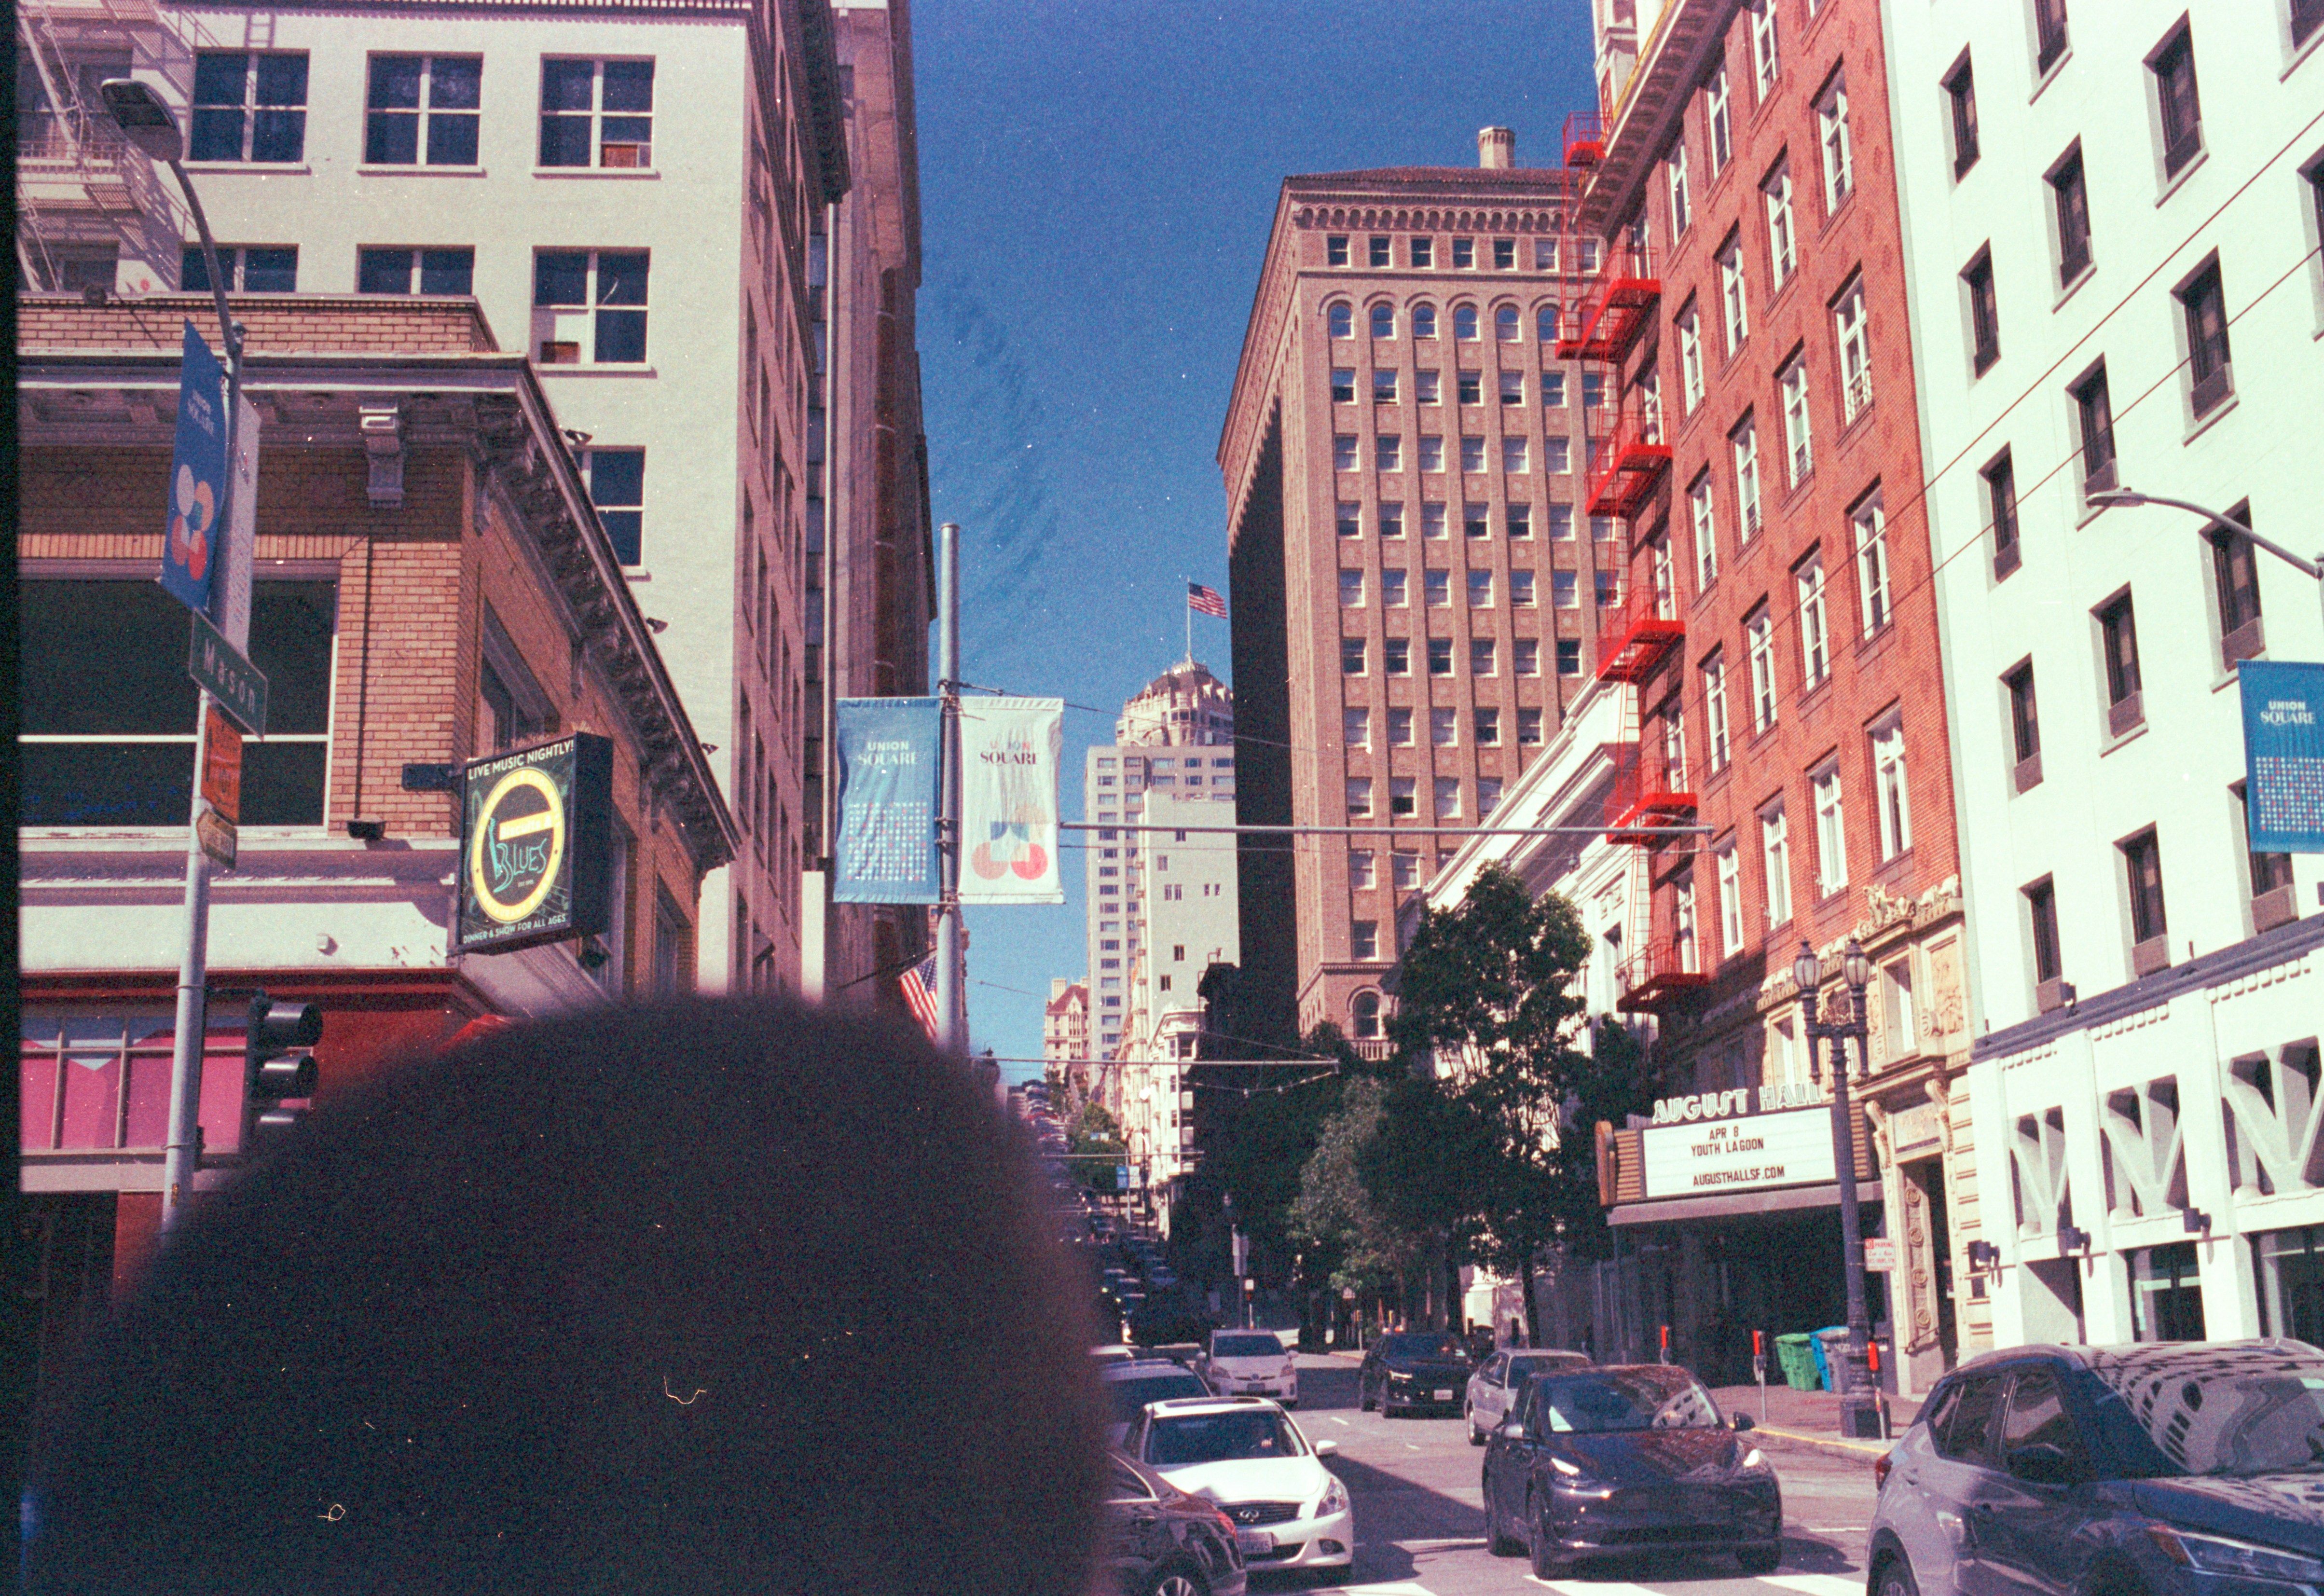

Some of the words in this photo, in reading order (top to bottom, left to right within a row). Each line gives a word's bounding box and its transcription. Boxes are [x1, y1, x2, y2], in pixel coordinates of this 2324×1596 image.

[2268, 701, 2306, 711] UNION
[2260, 711, 2316, 726] SQUARE
[867, 741, 909, 751] UNION
[468, 764, 490, 780] LIVE
[493, 754, 524, 772] MUSIC
[527, 740, 574, 764] NIGHTLY!
[858, 752, 917, 767] SQUARE
[980, 751, 1037, 766] SQUARE
[499, 820, 542, 840] Biscuits
[544, 814, 552, 827] &
[463, 930, 488, 944] DINNER
[489, 930, 495, 938] &
[495, 925, 516, 936] SHOW
[518, 922, 533, 931] FOR
[533, 919, 546, 928] ALL
[548, 914, 566, 925] AGES
[1652, 1088, 1748, 1125] AUGUST
[1759, 1081, 1821, 1111] HALL
[1709, 1128, 1727, 1140] APR
[1733, 1126, 1739, 1137] 8
[1691, 1143, 1720, 1156] YOUTH
[1726, 1138, 1764, 1153] LAGOON
[1693, 1166, 1785, 1187] AUGUSTHALLSF.COM
